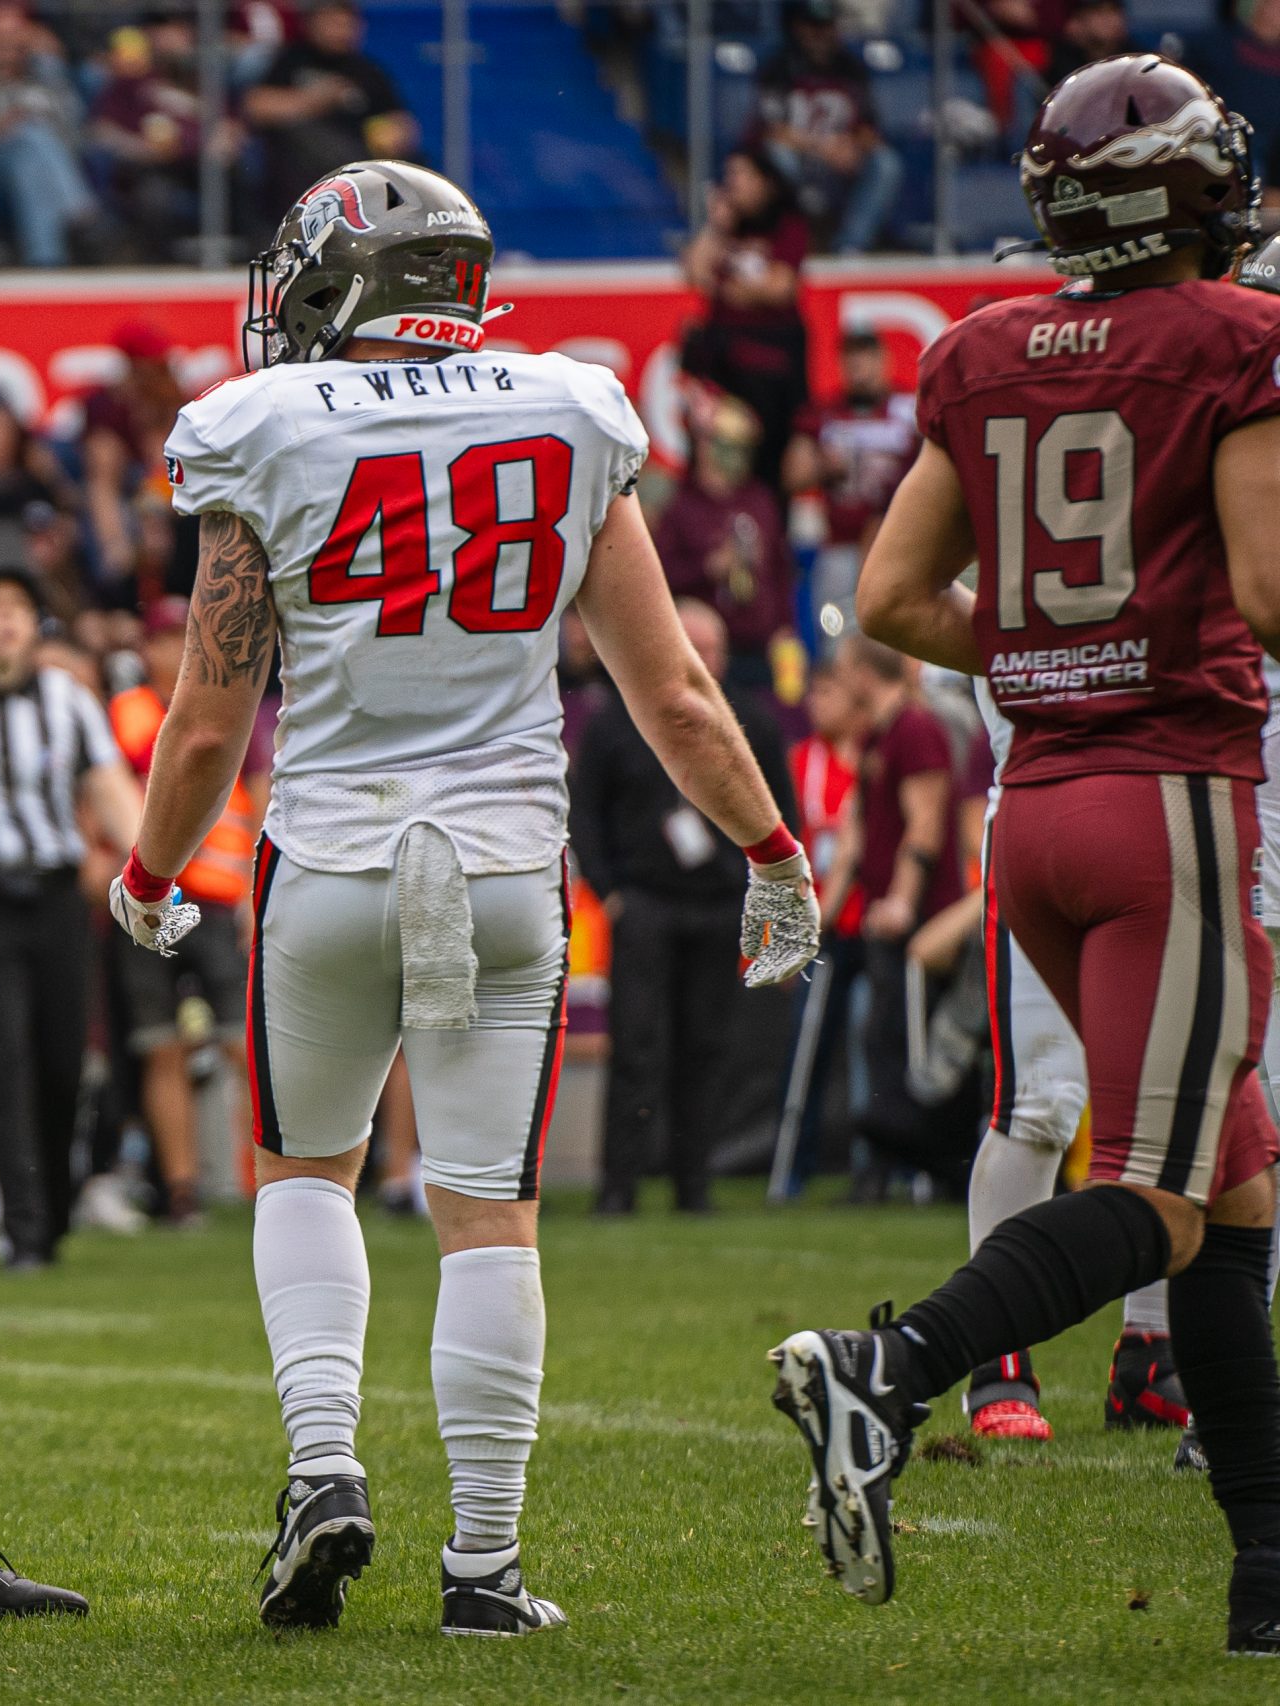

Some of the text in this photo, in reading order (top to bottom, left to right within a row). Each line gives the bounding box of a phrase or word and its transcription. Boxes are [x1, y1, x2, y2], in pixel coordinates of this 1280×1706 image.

[1026, 317, 1113, 358] BAH
[307, 433, 574, 638] 48
[984, 409, 1136, 630] 19
[990, 638, 1149, 673] AMERICAN
[990, 661, 1149, 695] TOURISTER
